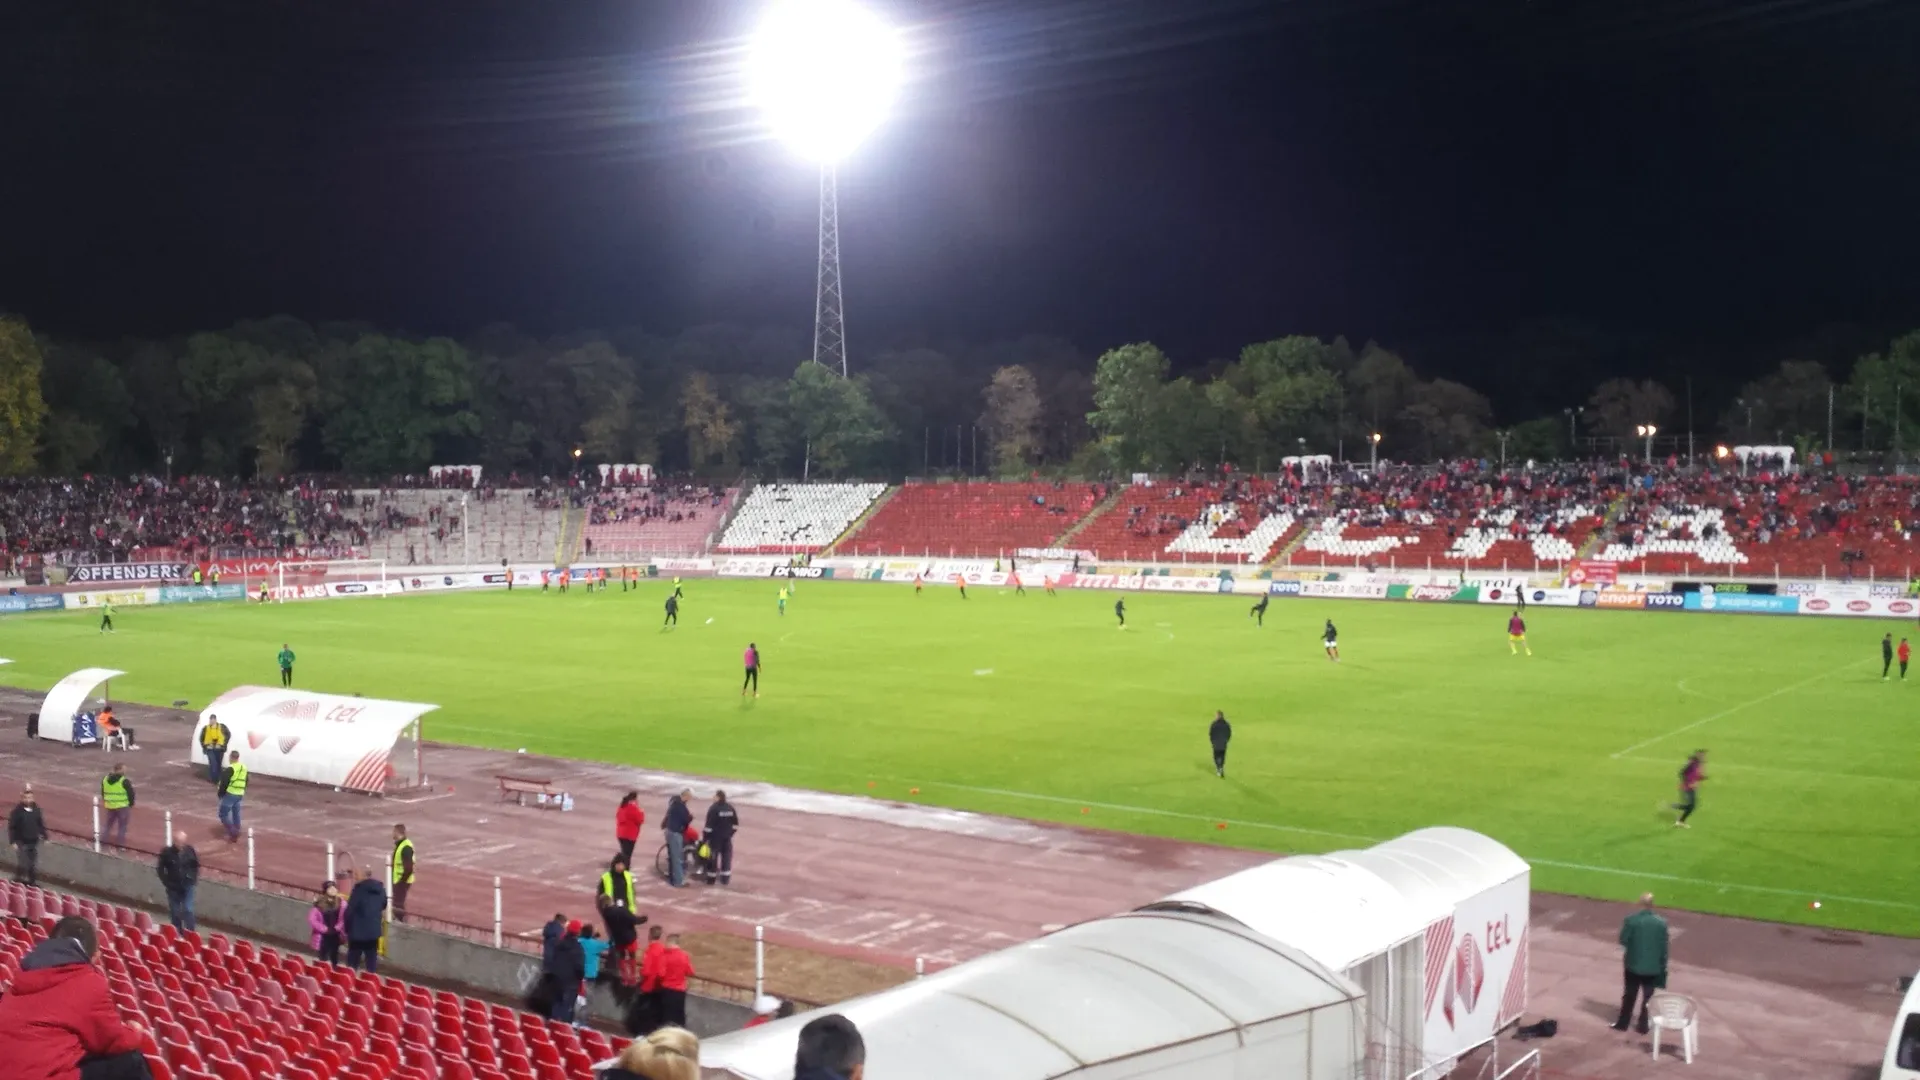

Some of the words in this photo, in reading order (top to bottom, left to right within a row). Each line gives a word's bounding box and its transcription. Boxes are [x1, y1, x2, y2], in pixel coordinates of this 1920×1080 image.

[77, 565, 181, 580] OFFENDERS
[325, 704, 366, 723] tel
[1486, 914, 1511, 953] tel
